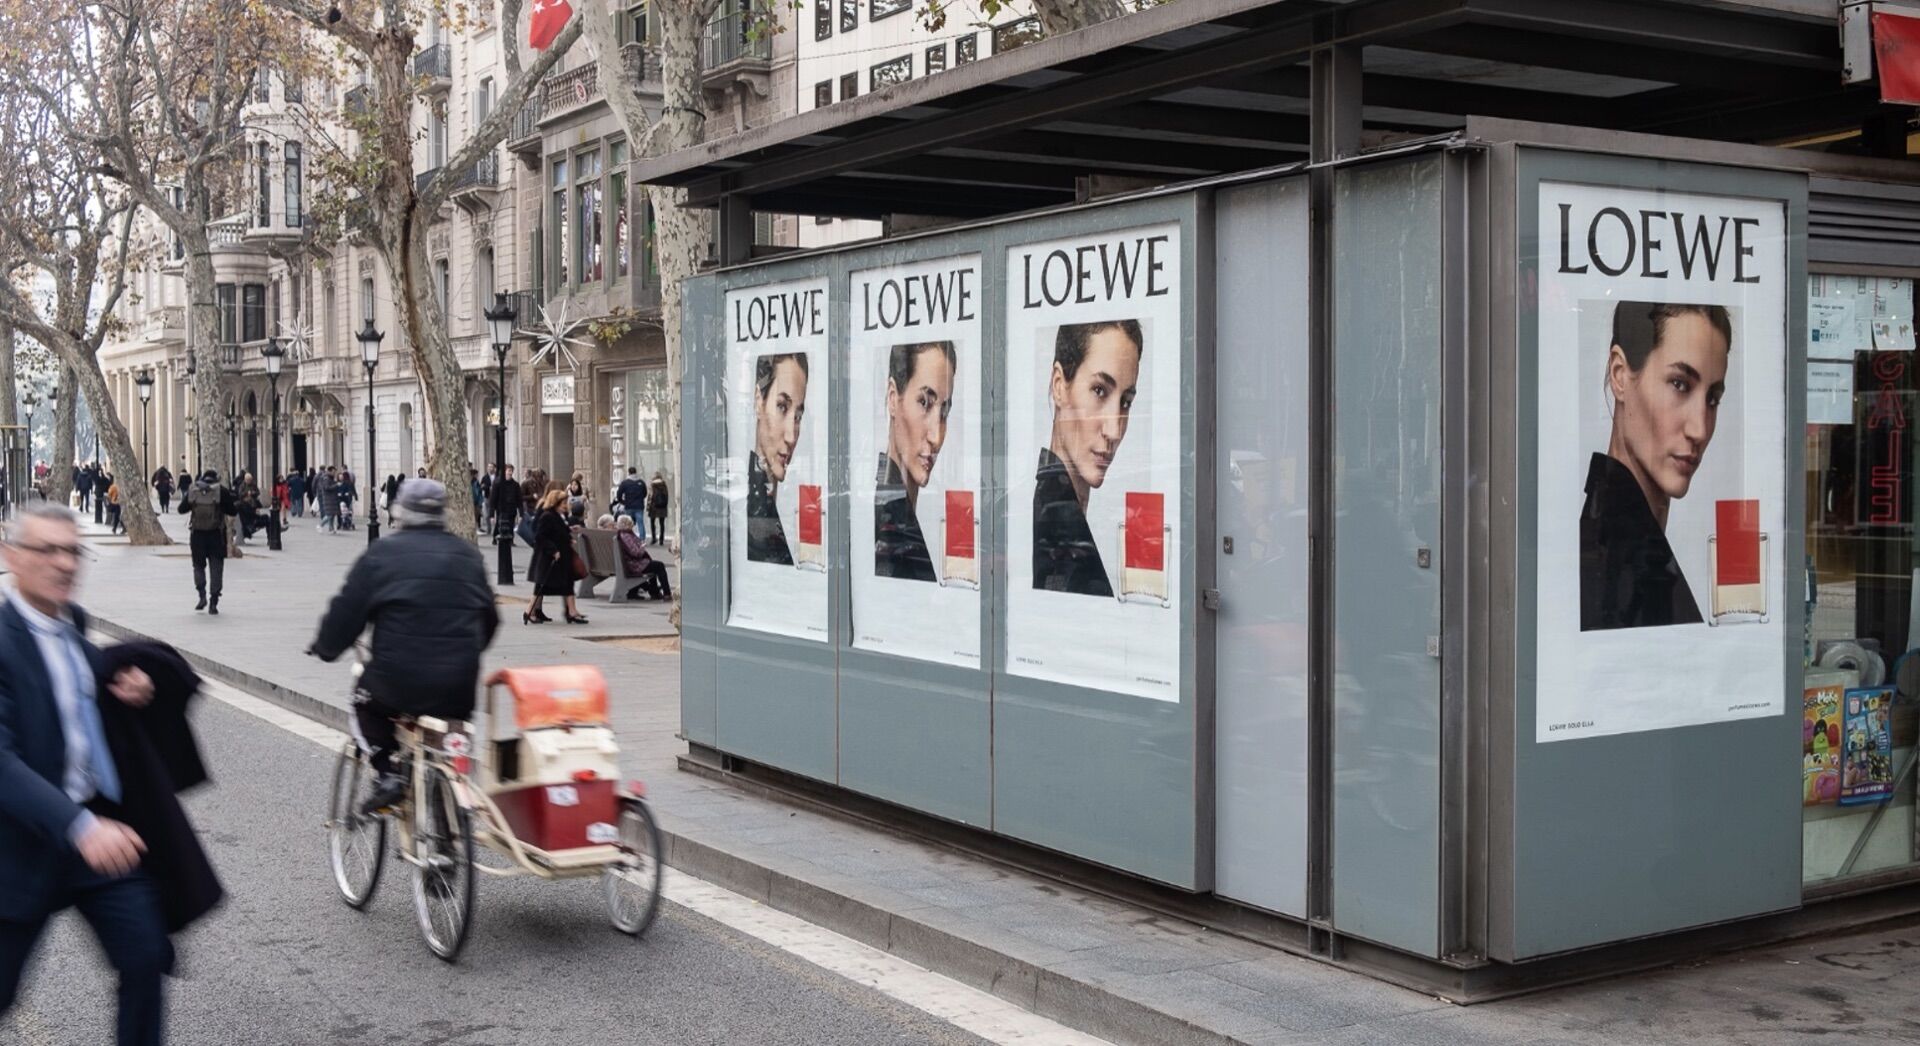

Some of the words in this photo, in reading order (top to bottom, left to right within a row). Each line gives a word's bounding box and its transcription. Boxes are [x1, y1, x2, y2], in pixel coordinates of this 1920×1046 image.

[1022, 234, 1169, 310] LOEWE
[1557, 202, 1761, 284] LOEWE
[735, 288, 824, 343] LOEWE
[862, 267, 975, 332] LOEWE
